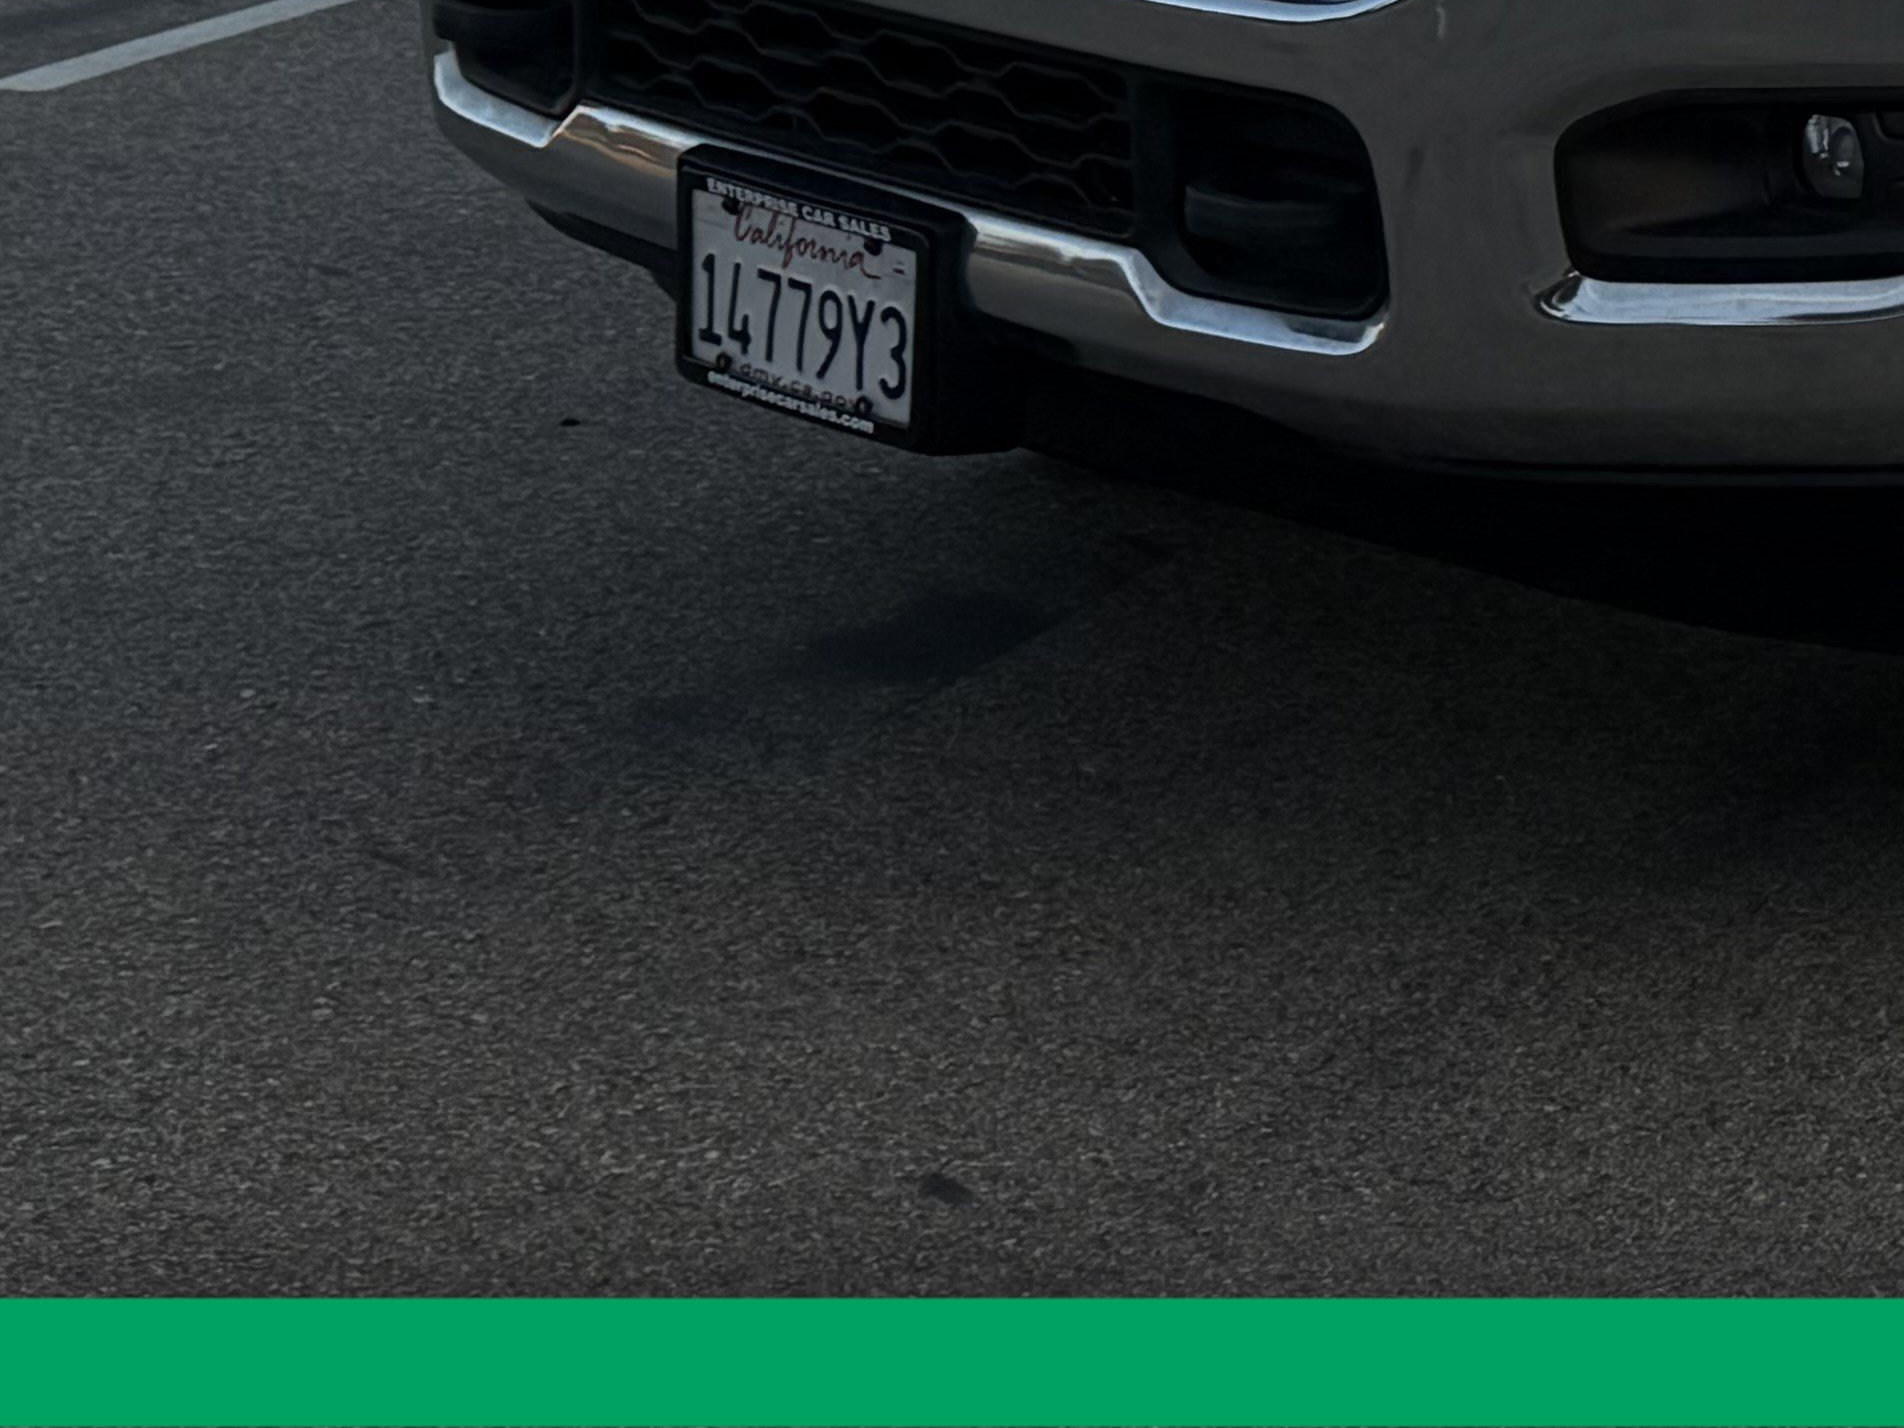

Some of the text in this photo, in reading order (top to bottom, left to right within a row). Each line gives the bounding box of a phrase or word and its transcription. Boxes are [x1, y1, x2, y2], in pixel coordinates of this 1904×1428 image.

[706, 177, 891, 242] ENTERPRISE CAR SALES
[734, 204, 882, 280] California
[699, 252, 908, 400] 14779Y3
[707, 370, 875, 435] enterprisecarsales.com
